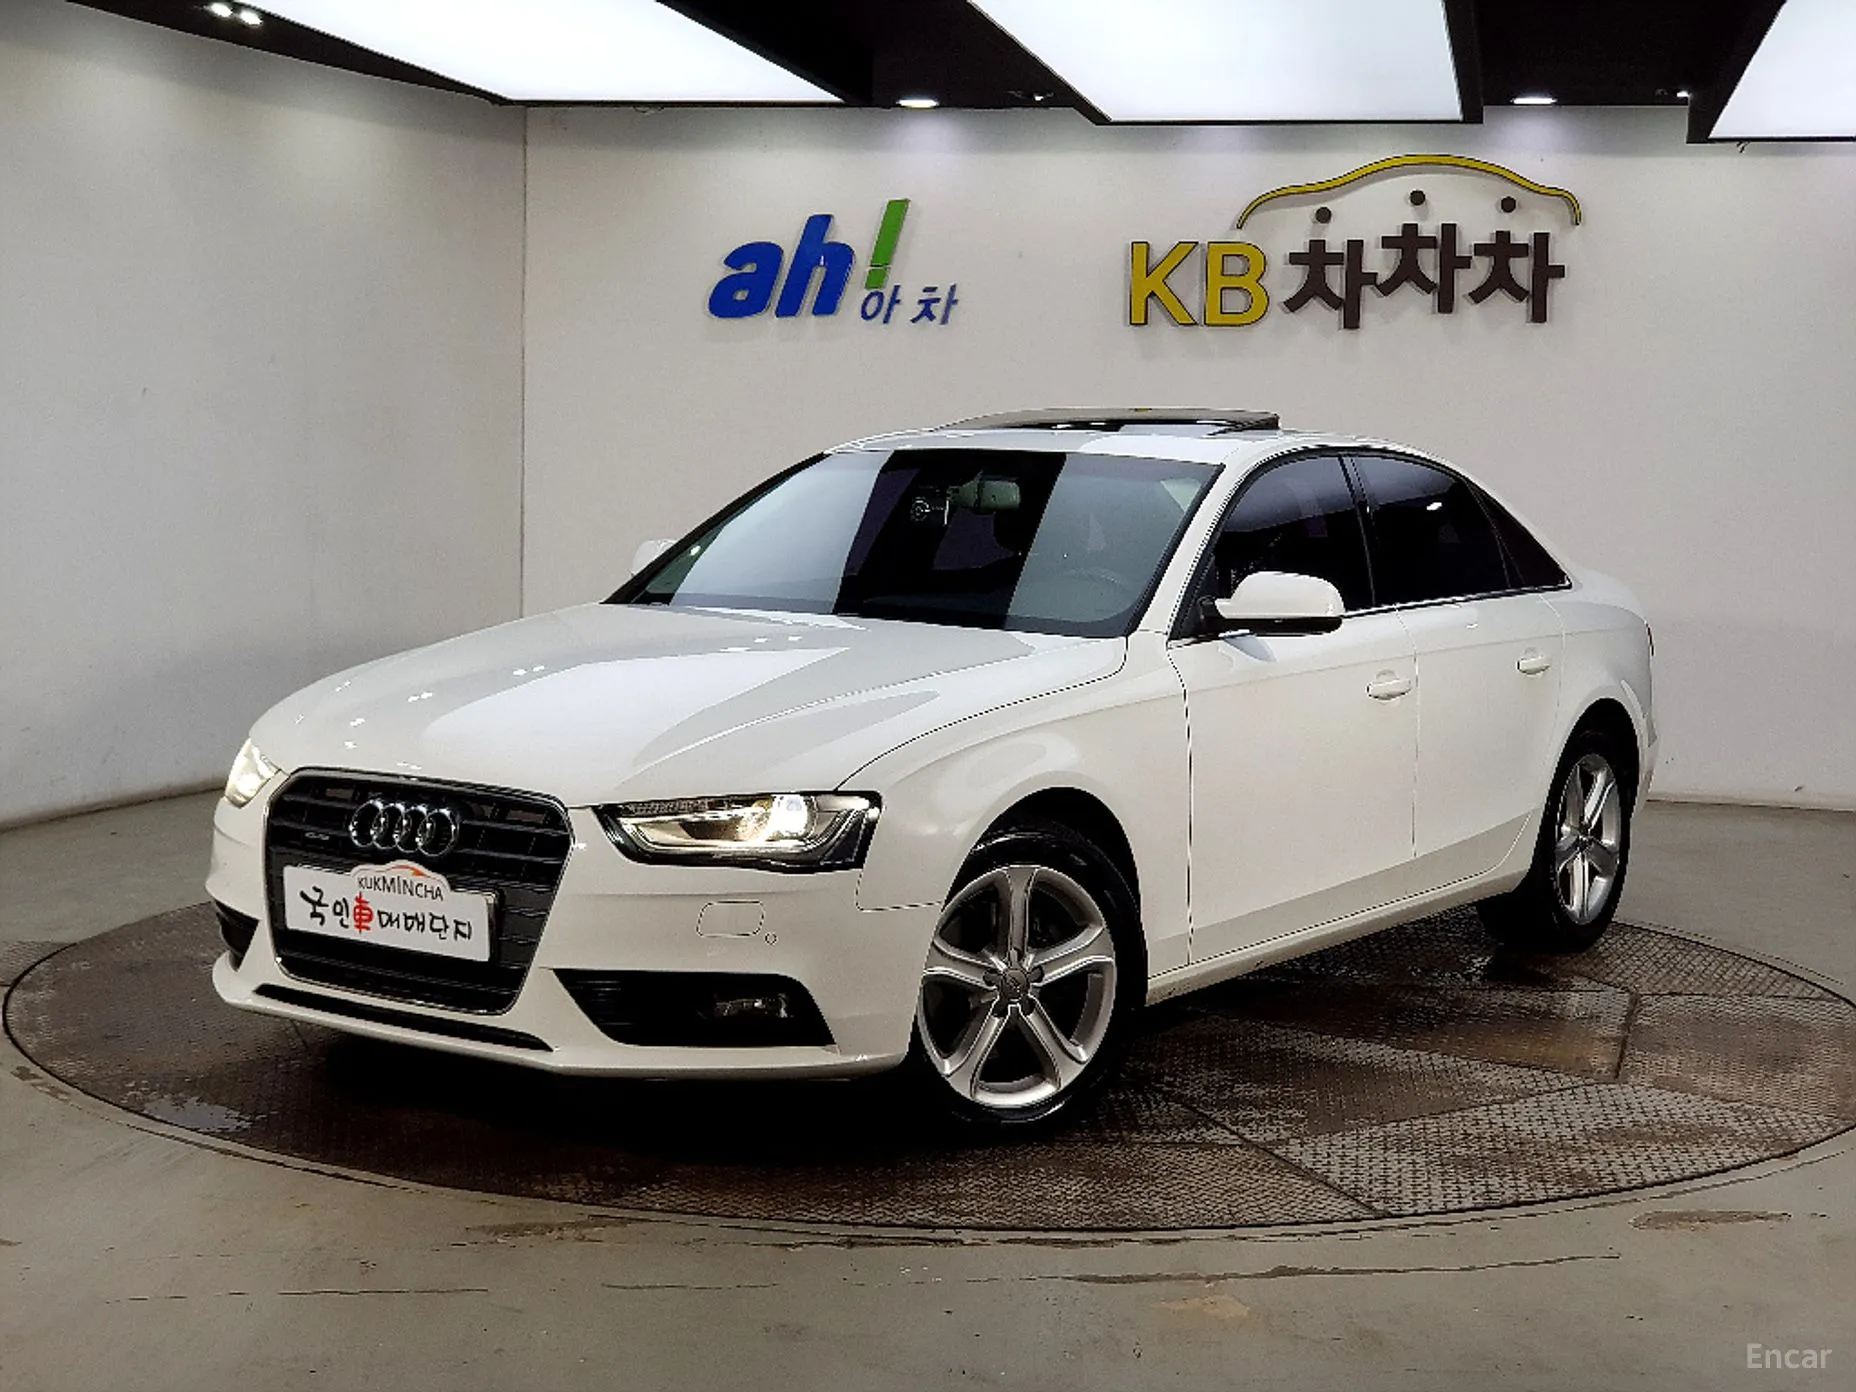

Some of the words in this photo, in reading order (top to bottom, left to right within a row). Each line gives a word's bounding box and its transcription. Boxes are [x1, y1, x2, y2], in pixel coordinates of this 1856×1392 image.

[708, 198, 910, 318] ah!
[1129, 241, 1270, 326] KB
[1283, 189, 1566, 329] 차차차
[860, 283, 959, 325] 아차
[358, 875, 443, 901] KUKMINCHA
